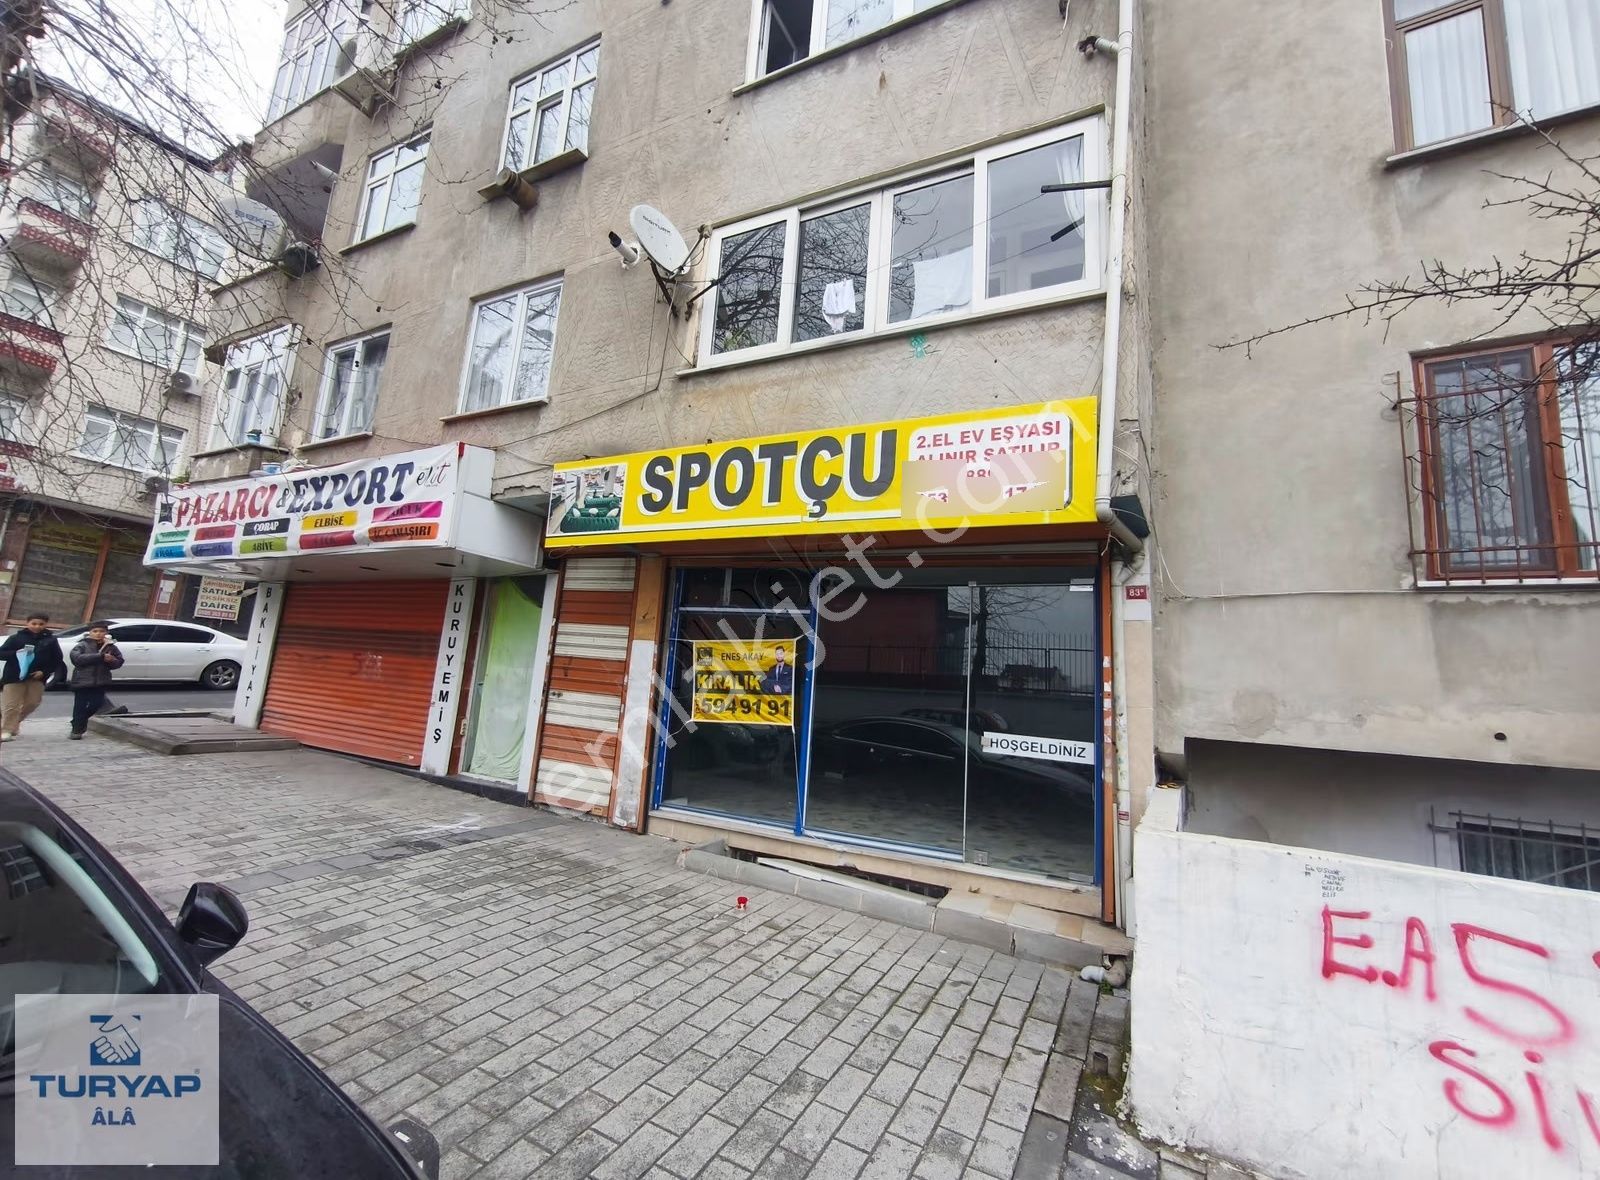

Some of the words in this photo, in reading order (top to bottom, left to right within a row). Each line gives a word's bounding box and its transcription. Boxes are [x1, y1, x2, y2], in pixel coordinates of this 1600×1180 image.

[916, 433, 953, 449] 2.EL
[960, 429, 984, 444] EV
[991, 420, 1061, 443] EŞYASI
[639, 429, 897, 520] SPOTÇU
[175, 483, 278, 528] PAZARCI
[286, 461, 415, 514] EXPORT
[314, 514, 344, 528] ELBİSE
[202, 587, 232, 596] SATIL
[244, 586, 273, 707] BAKLİYAT
[721, 652, 741, 661] ENES
[743, 652, 765, 661] AKAY
[433, 584, 465, 744] KURUYEMİŞ
[990, 738, 1087, 759] HOŞGELDİNİZ
